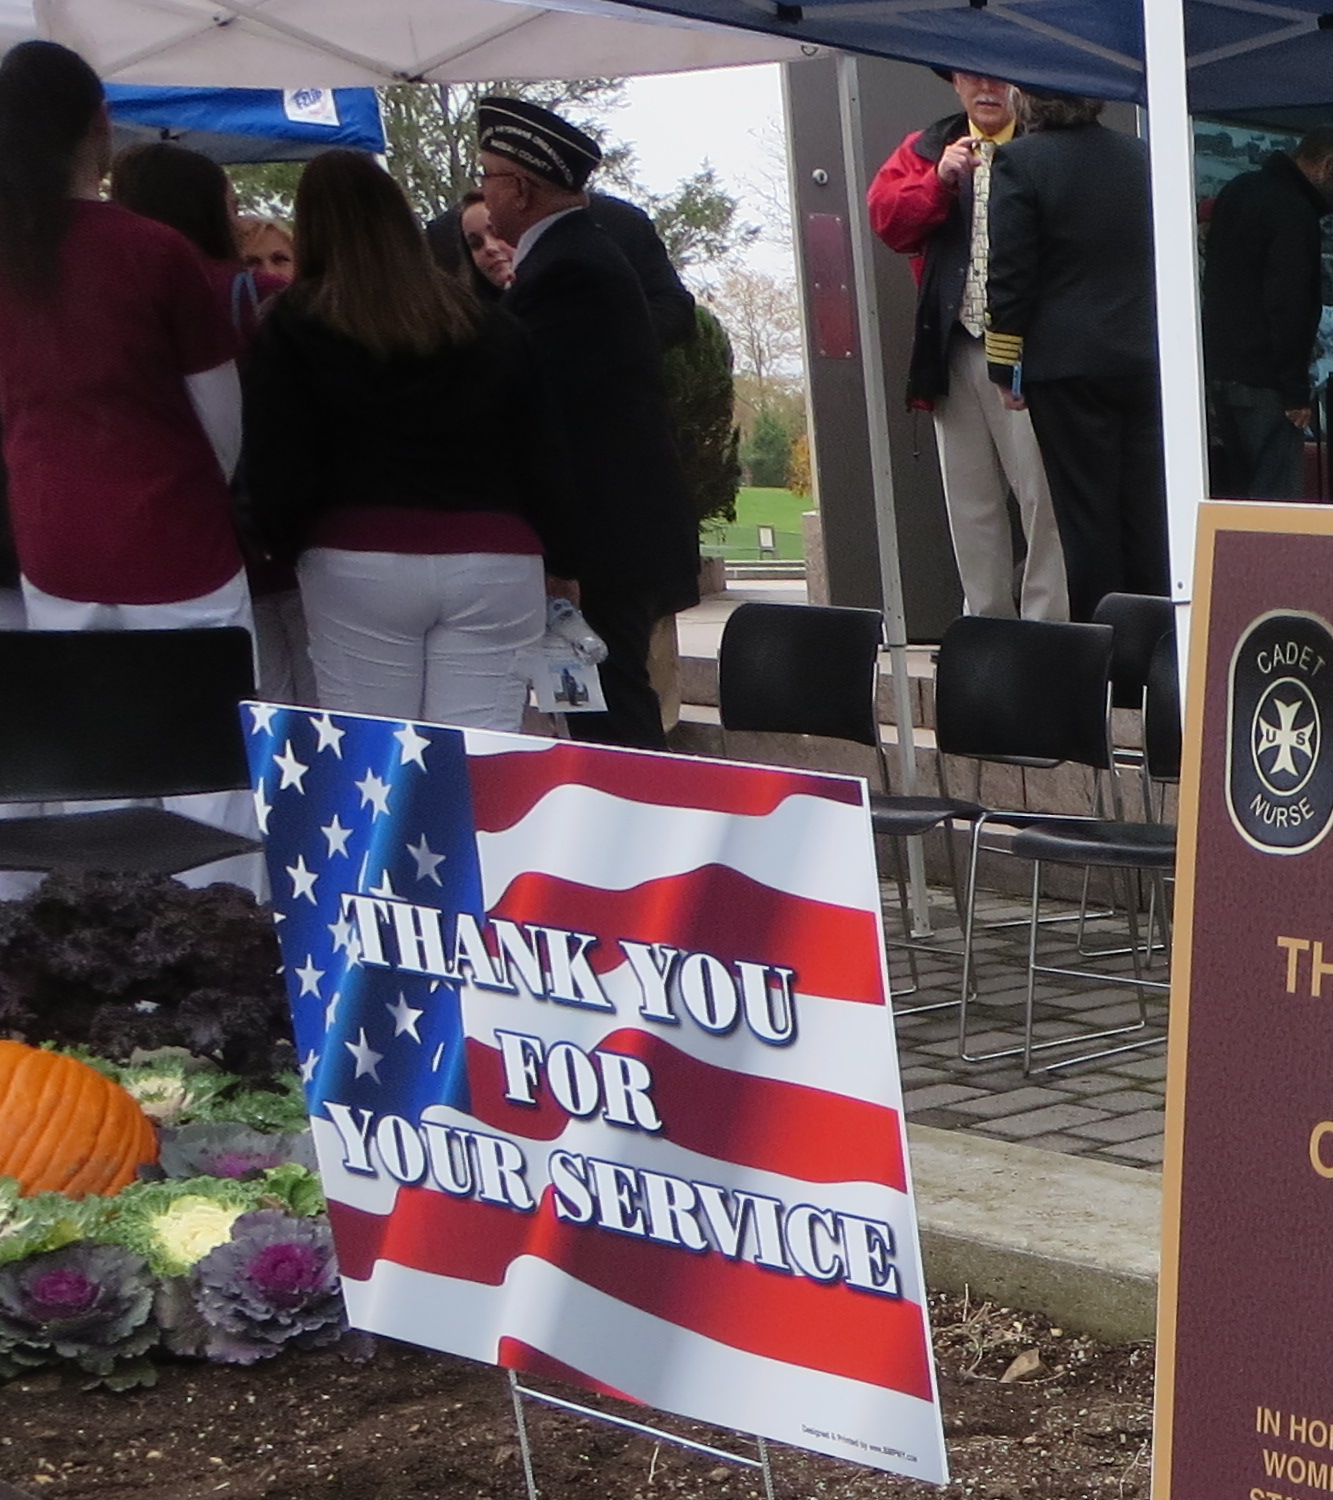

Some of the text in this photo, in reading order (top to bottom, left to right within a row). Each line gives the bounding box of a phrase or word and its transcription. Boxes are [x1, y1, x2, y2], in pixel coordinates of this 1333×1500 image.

[517, 149, 553, 171] COUNTY
[1257, 641, 1326, 676] CADET
[1265, 729, 1306, 746] U S
[1250, 793, 1315, 828] NURSE
[340, 891, 797, 1046] THANK YOU
[496, 1028, 661, 1134] FOR
[323, 1100, 903, 1298] YOUR SERVICE
[1257, 1408, 1280, 1434] IN
